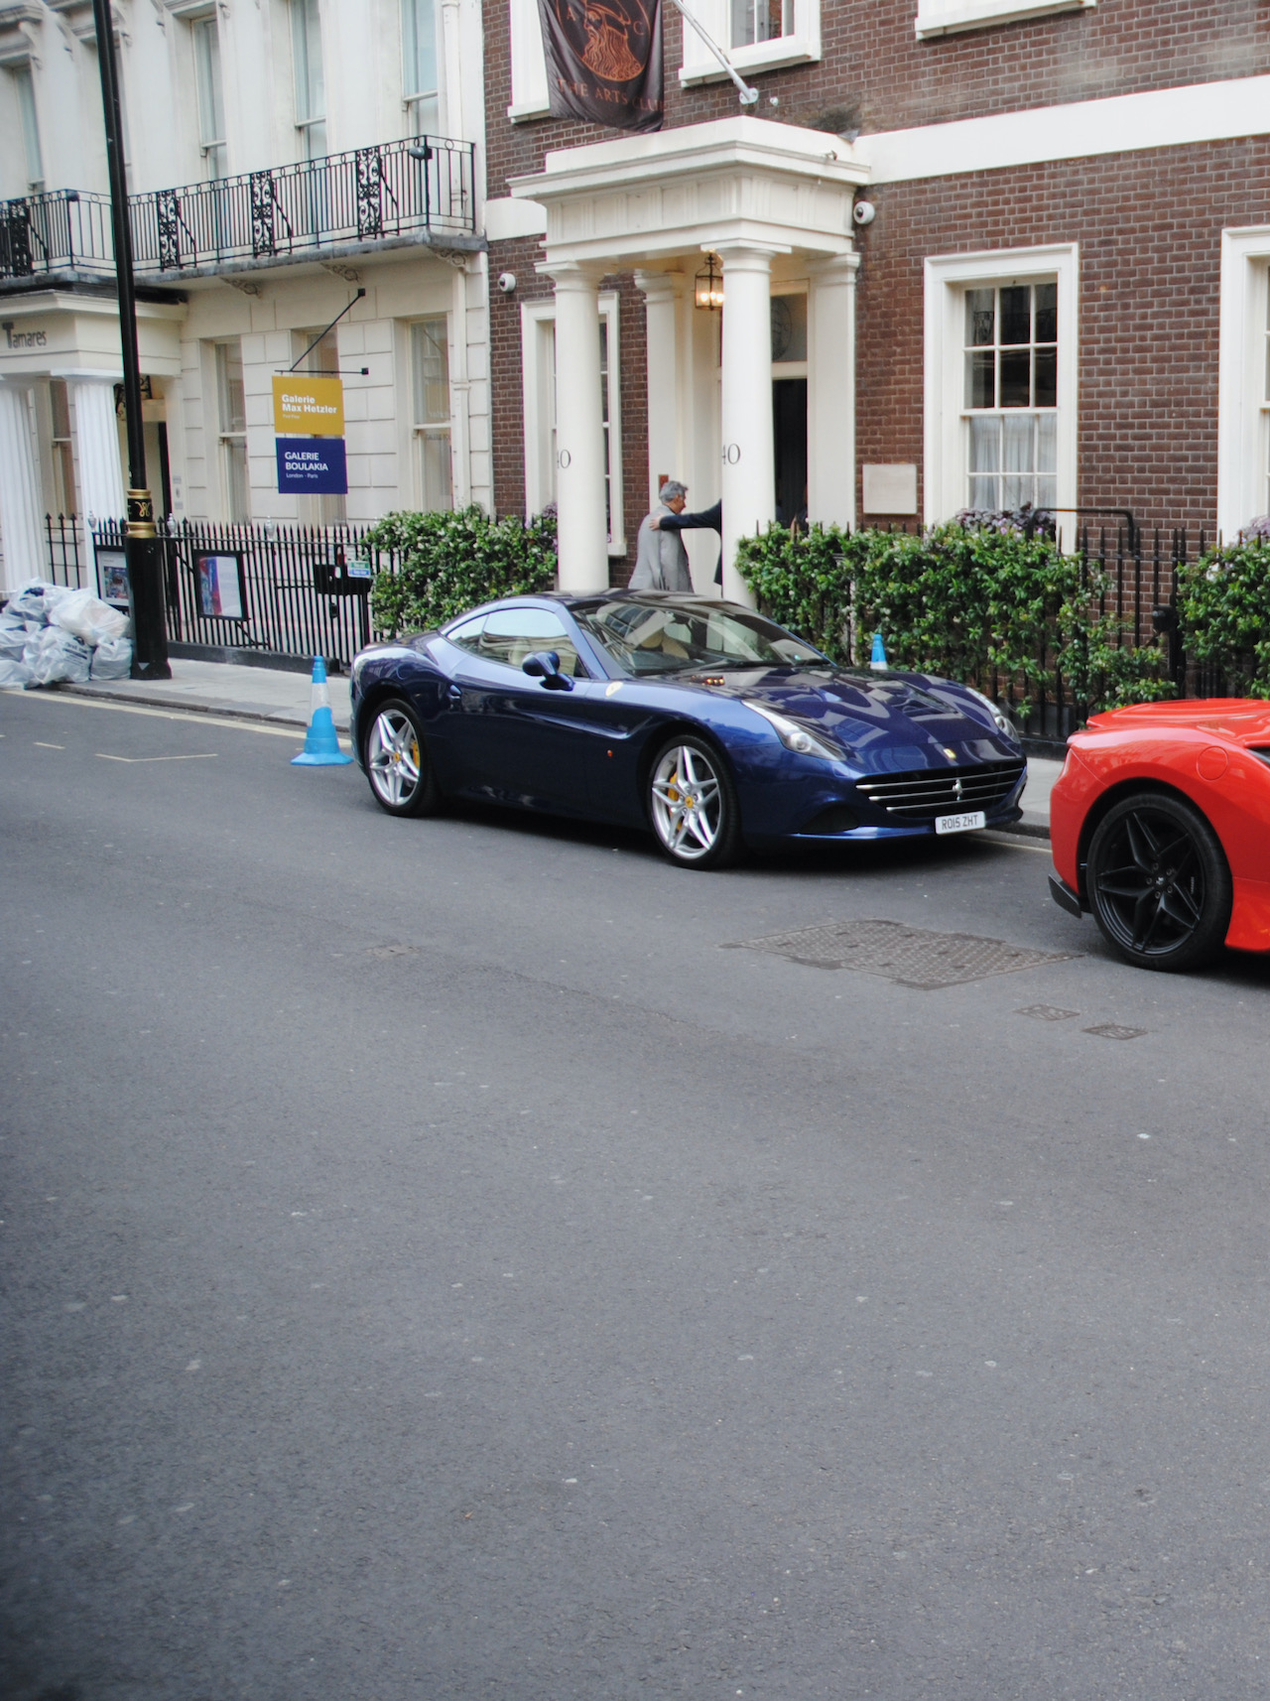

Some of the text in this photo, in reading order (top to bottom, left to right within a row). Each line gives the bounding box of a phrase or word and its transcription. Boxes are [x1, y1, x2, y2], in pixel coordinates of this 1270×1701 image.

[567, 6, 577, 21] A
[633, 21, 644, 35] C
[559, 78, 589, 97] THE
[595, 87, 628, 105] ARTS
[2, 322, 47, 348] Tamares
[281, 394, 316, 404] Galerie
[282, 404, 338, 414] Max Hetzler
[284, 452, 319, 460] GALERIE
[285, 462, 328, 471] BOULAKIA
[941, 814, 978, 830] RO15 ZHT
